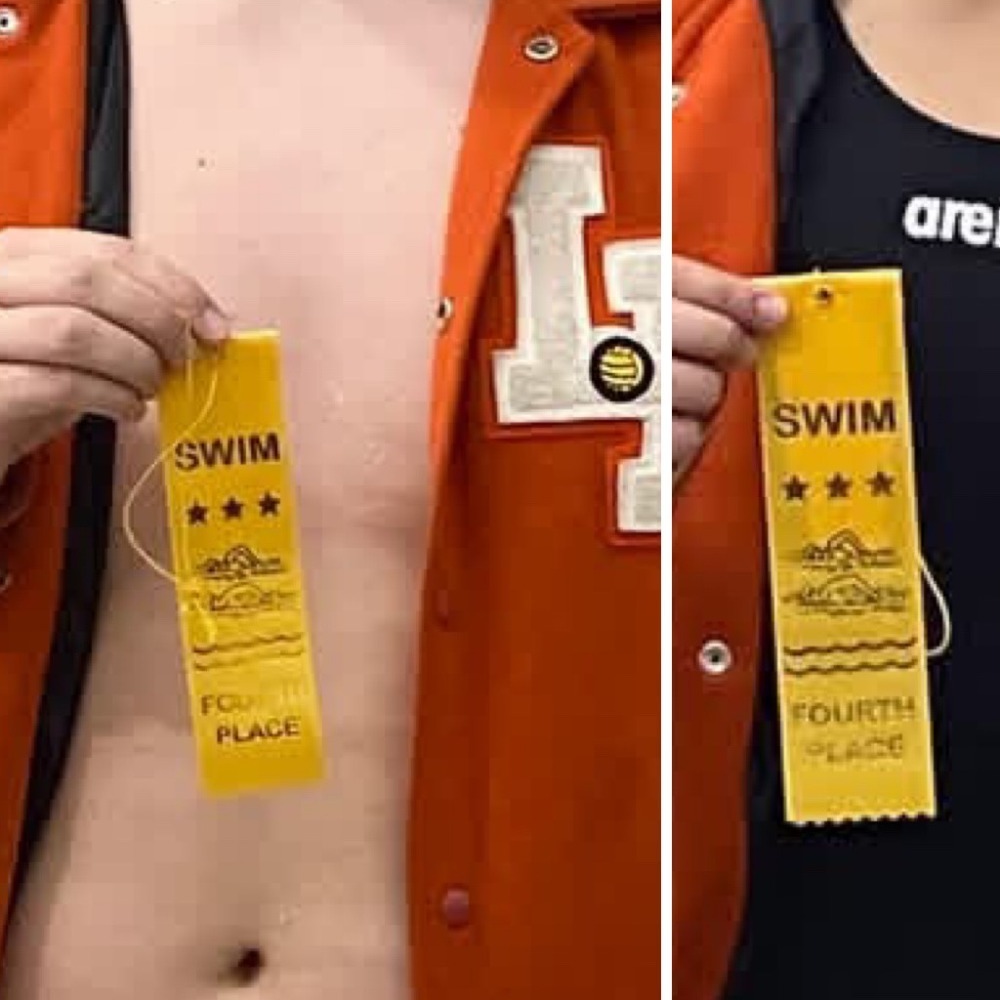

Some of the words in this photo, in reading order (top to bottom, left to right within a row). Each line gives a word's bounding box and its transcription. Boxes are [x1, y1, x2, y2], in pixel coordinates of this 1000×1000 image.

[772, 397, 898, 440] SWIM
[173, 432, 281, 472] SWIM
[791, 695, 915, 726] FOURTH
[216, 715, 301, 745] PLACE
